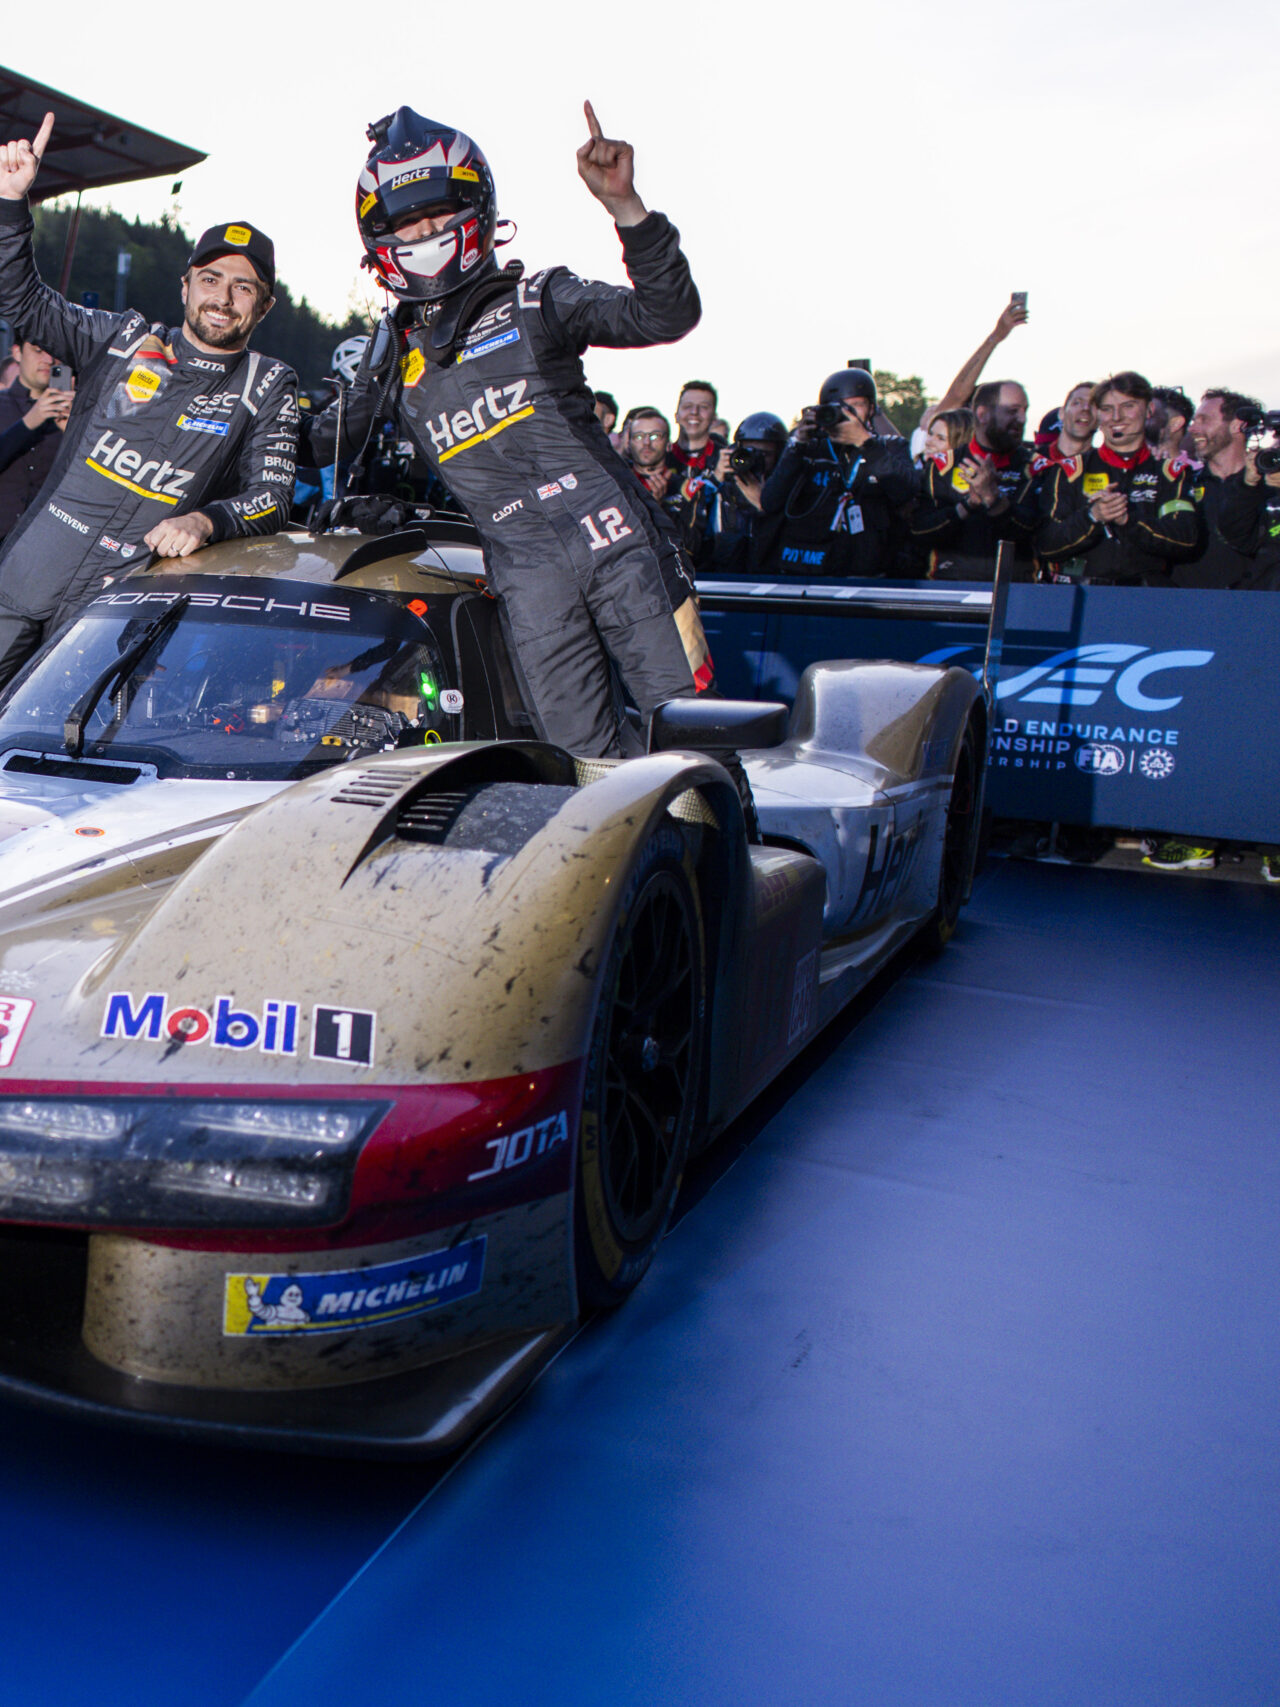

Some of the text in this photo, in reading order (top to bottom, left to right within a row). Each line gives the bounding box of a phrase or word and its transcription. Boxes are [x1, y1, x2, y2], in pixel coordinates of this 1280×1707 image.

[391, 168, 431, 187] Hertz
[121, 314, 145, 342] RX
[470, 301, 513, 333] EC
[473, 333, 514, 353] MICHELIN
[187, 357, 226, 373] JOTA
[255, 362, 285, 398] HRX
[425, 379, 536, 455] Hertz
[266, 441, 297, 454] JOT
[89, 429, 196, 499] Hertz
[48, 503, 90, 534] W.STEVENS
[231, 492, 277, 517] Hertz
[580, 506, 632, 550] 12
[88, 592, 351, 621] PORSCHE
[1026, 719, 1179, 745] ENDURANCE
[1077, 751, 1120, 770] FIA
[103, 993, 298, 1054] Mobil
[467, 1110, 569, 1182] JOTA
[316, 1261, 470, 1316] MICHELIN
